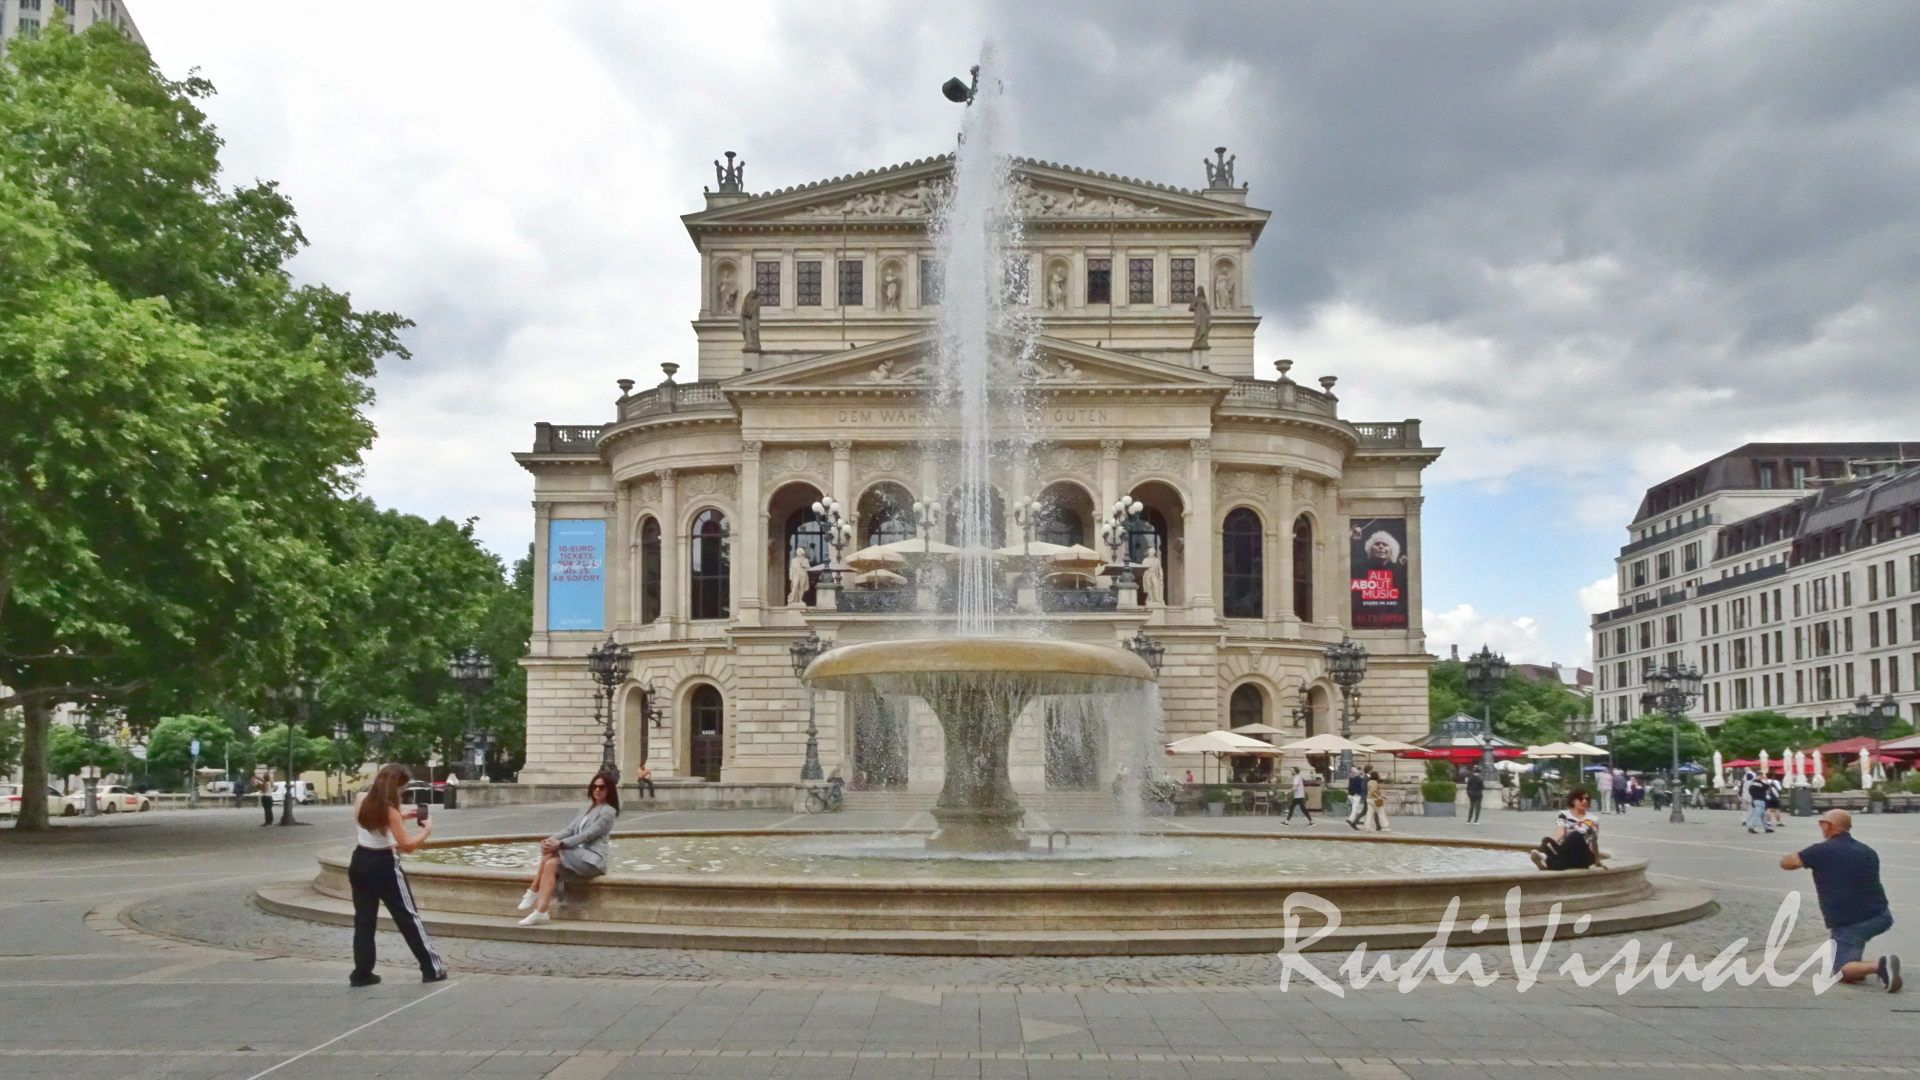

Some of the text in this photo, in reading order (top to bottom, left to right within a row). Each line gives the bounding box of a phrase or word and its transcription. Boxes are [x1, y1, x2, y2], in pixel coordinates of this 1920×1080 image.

[839, 410, 872, 422] DEM
[1370, 570, 1391, 580] ALL
[1351, 580, 1391, 589] ABOUT
[1362, 589, 1398, 599] MUSIC
